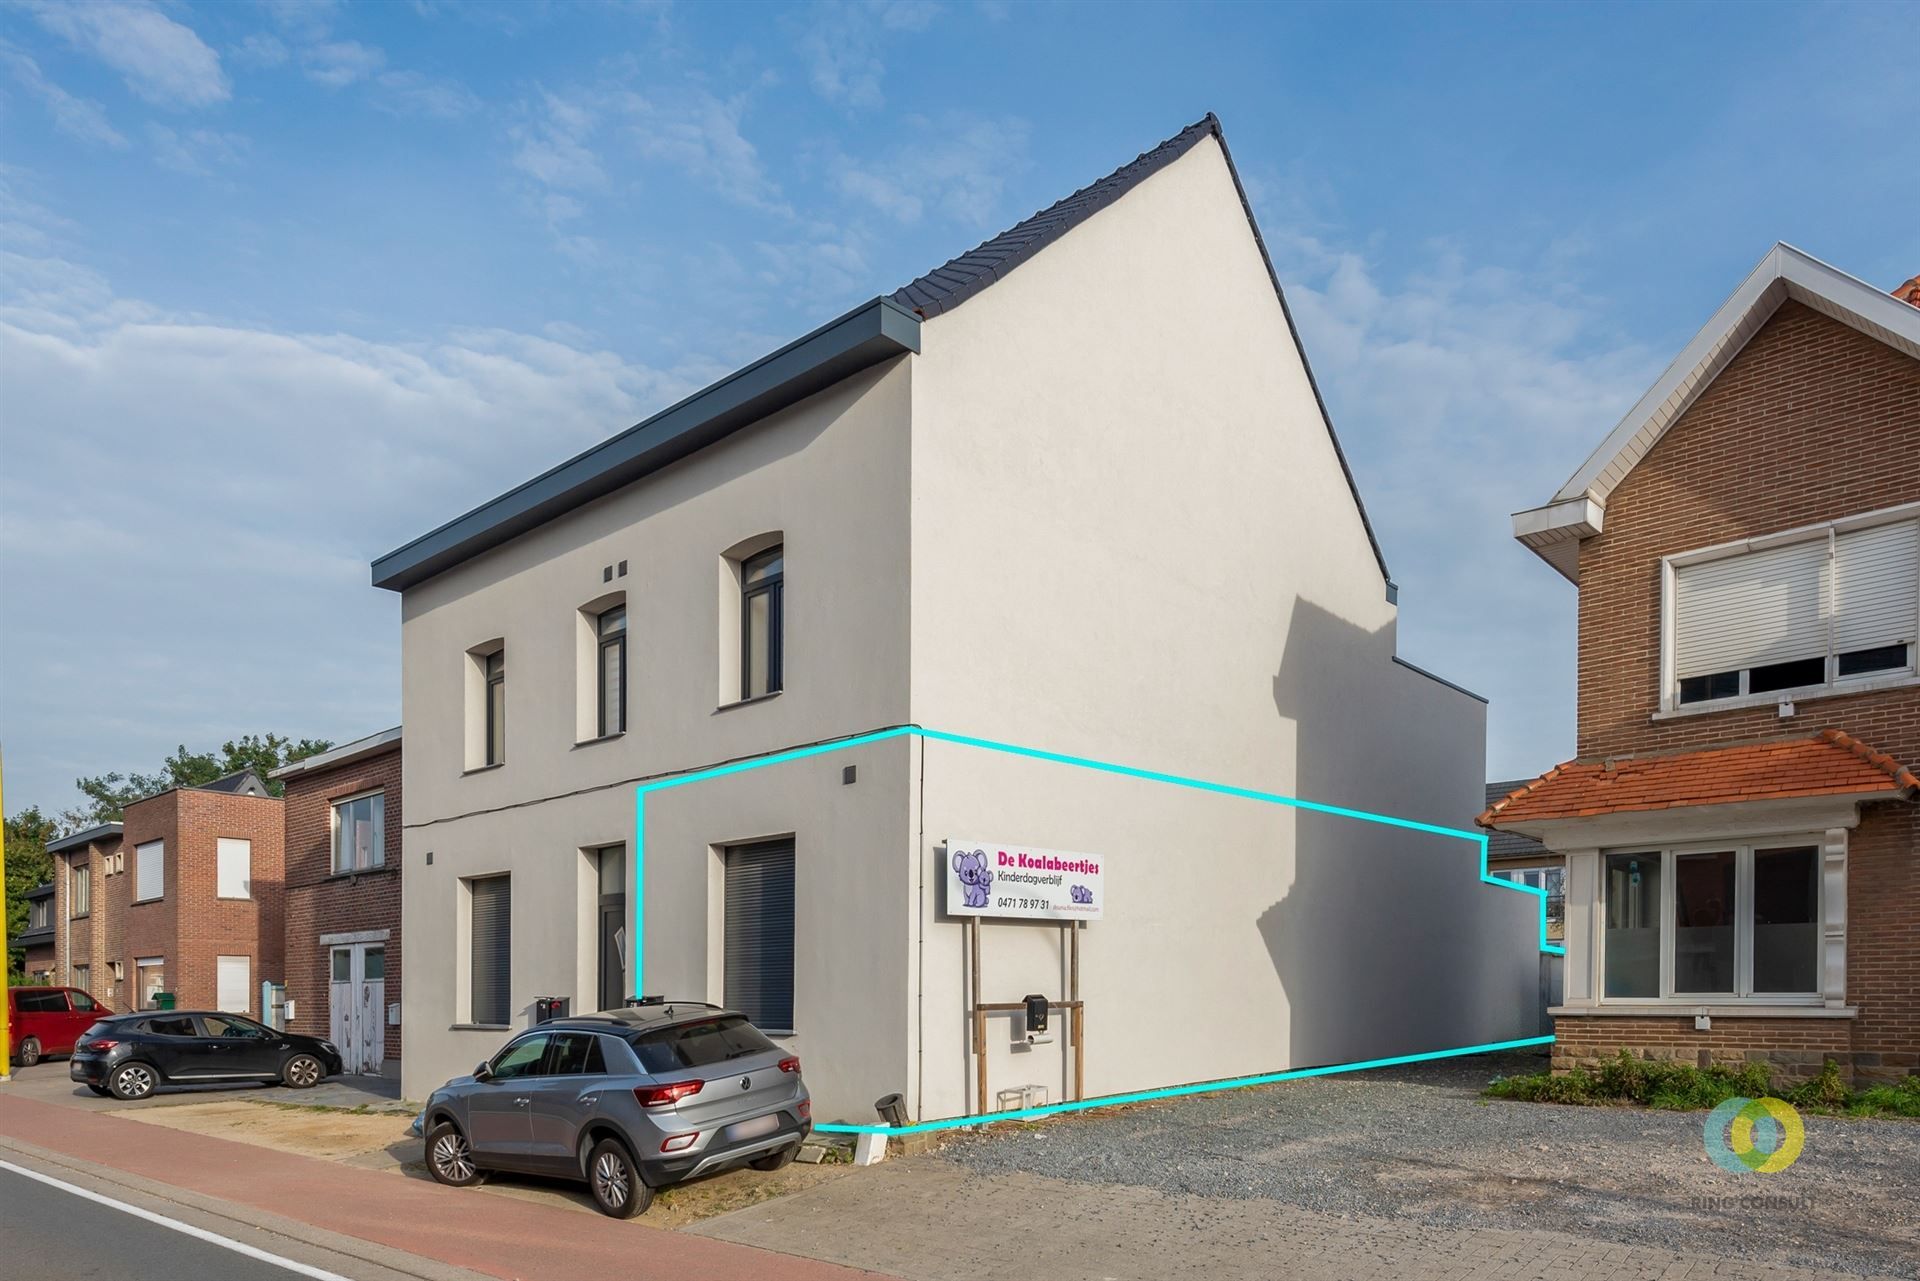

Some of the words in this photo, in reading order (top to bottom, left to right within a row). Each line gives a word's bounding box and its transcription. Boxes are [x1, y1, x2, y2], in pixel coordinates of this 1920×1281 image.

[998, 851, 1015, 866] De
[1018, 853, 1099, 875] Koalabeertjes
[998, 871, 1062, 887] Kinderdagverblijf
[998, 898, 1016, 908] 0471
[1019, 899, 1028, 909] 78
[1030, 899, 1040, 909] 97
[1041, 900, 1049, 909] 31
